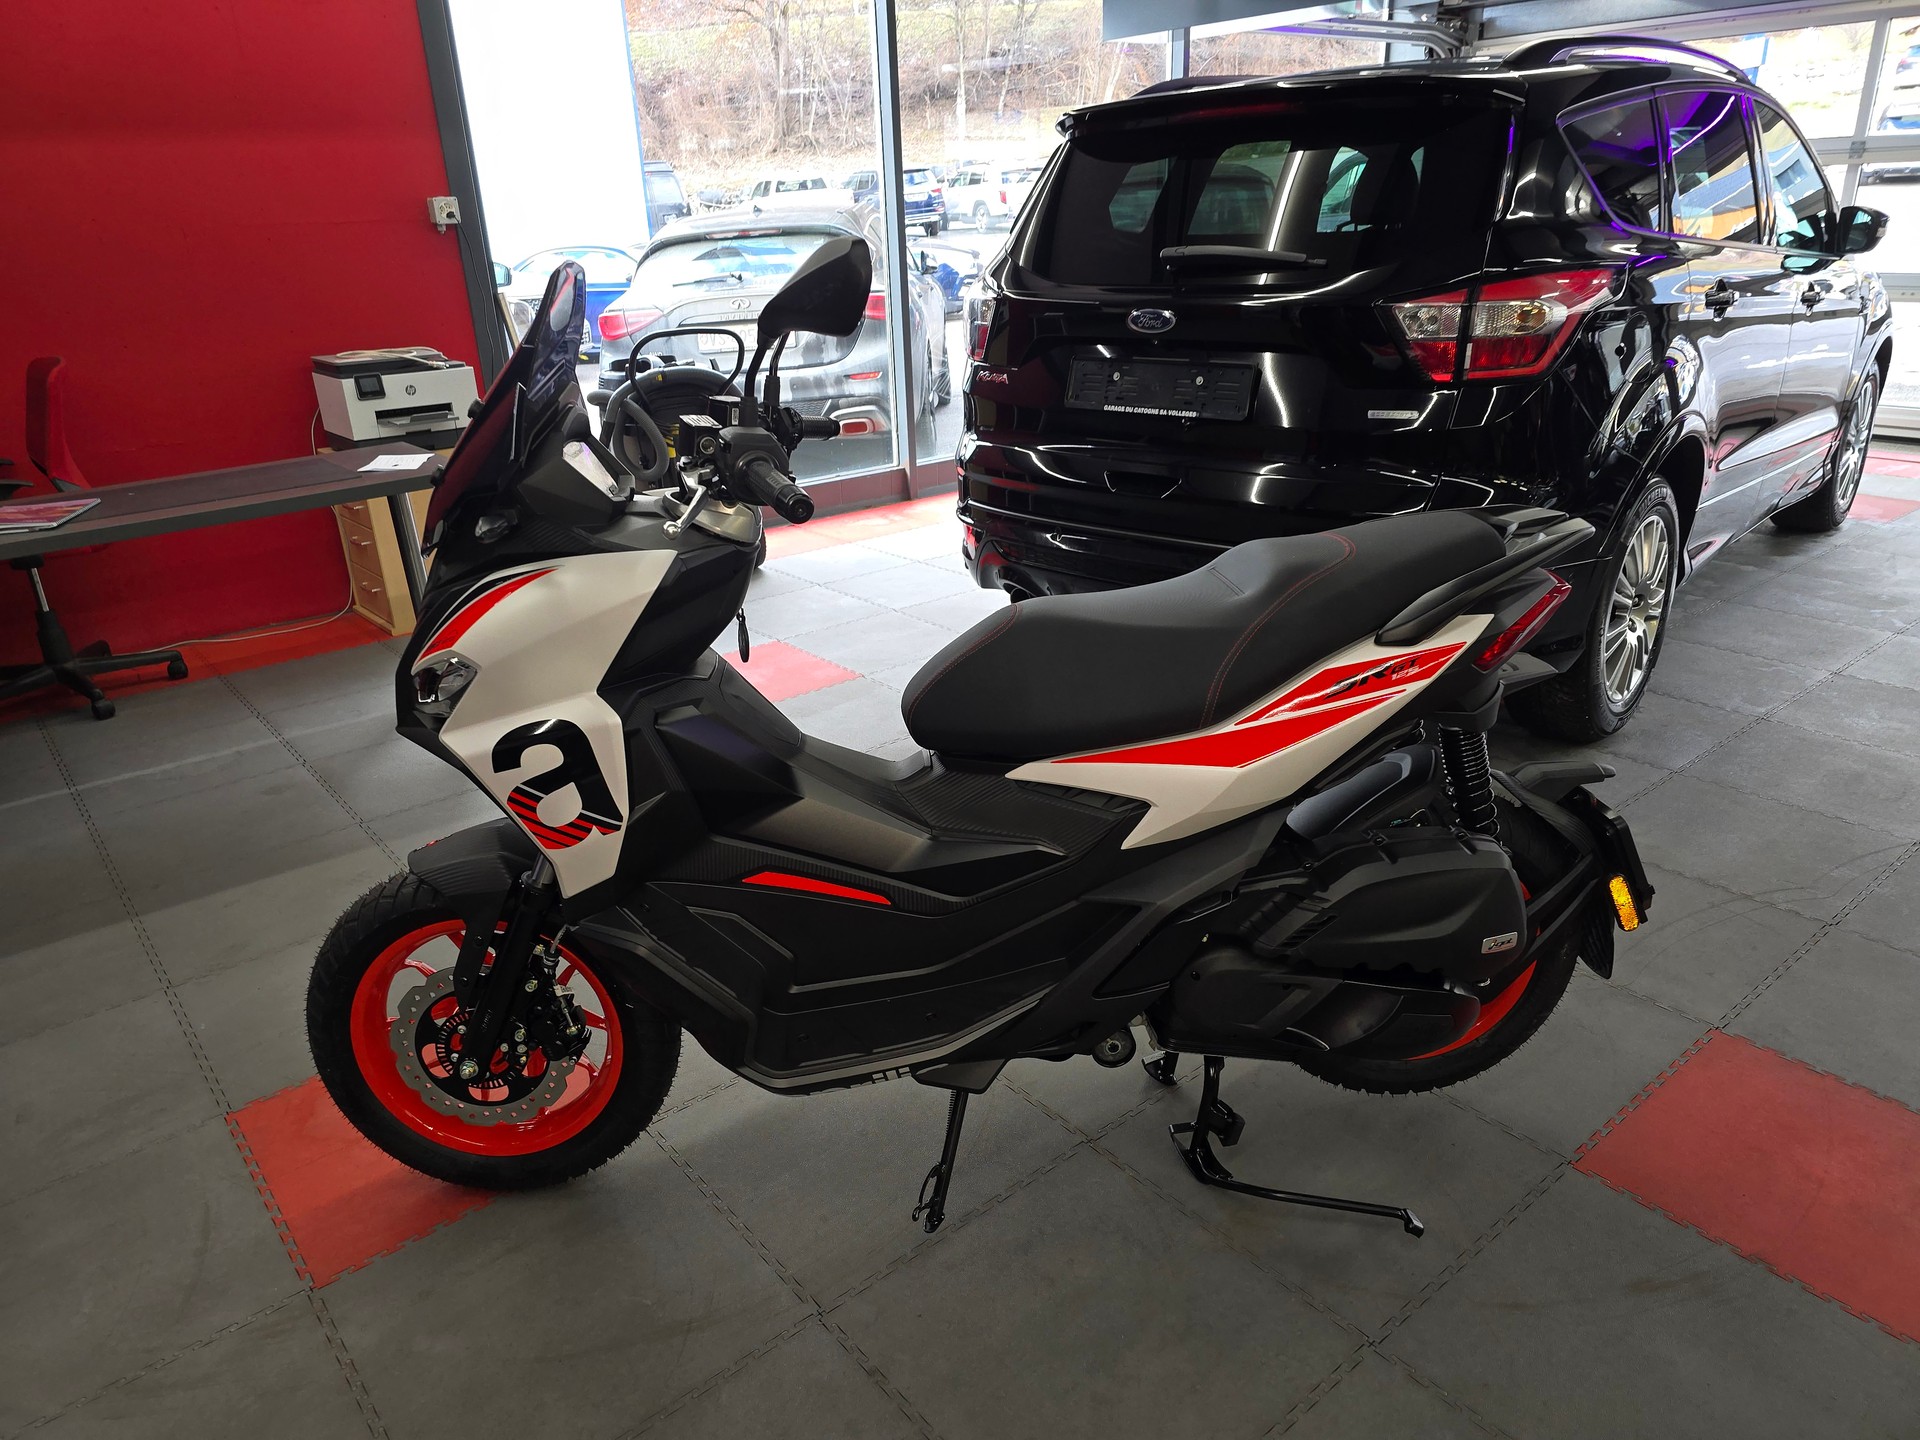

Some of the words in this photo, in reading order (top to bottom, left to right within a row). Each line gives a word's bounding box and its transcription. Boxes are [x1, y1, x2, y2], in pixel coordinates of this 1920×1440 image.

[1137, 312, 1165, 328] Ford
[1103, 404, 1125, 413] GARAGE
[1133, 406, 1159, 415] CATOGNE
[1159, 408, 1168, 416] SA
